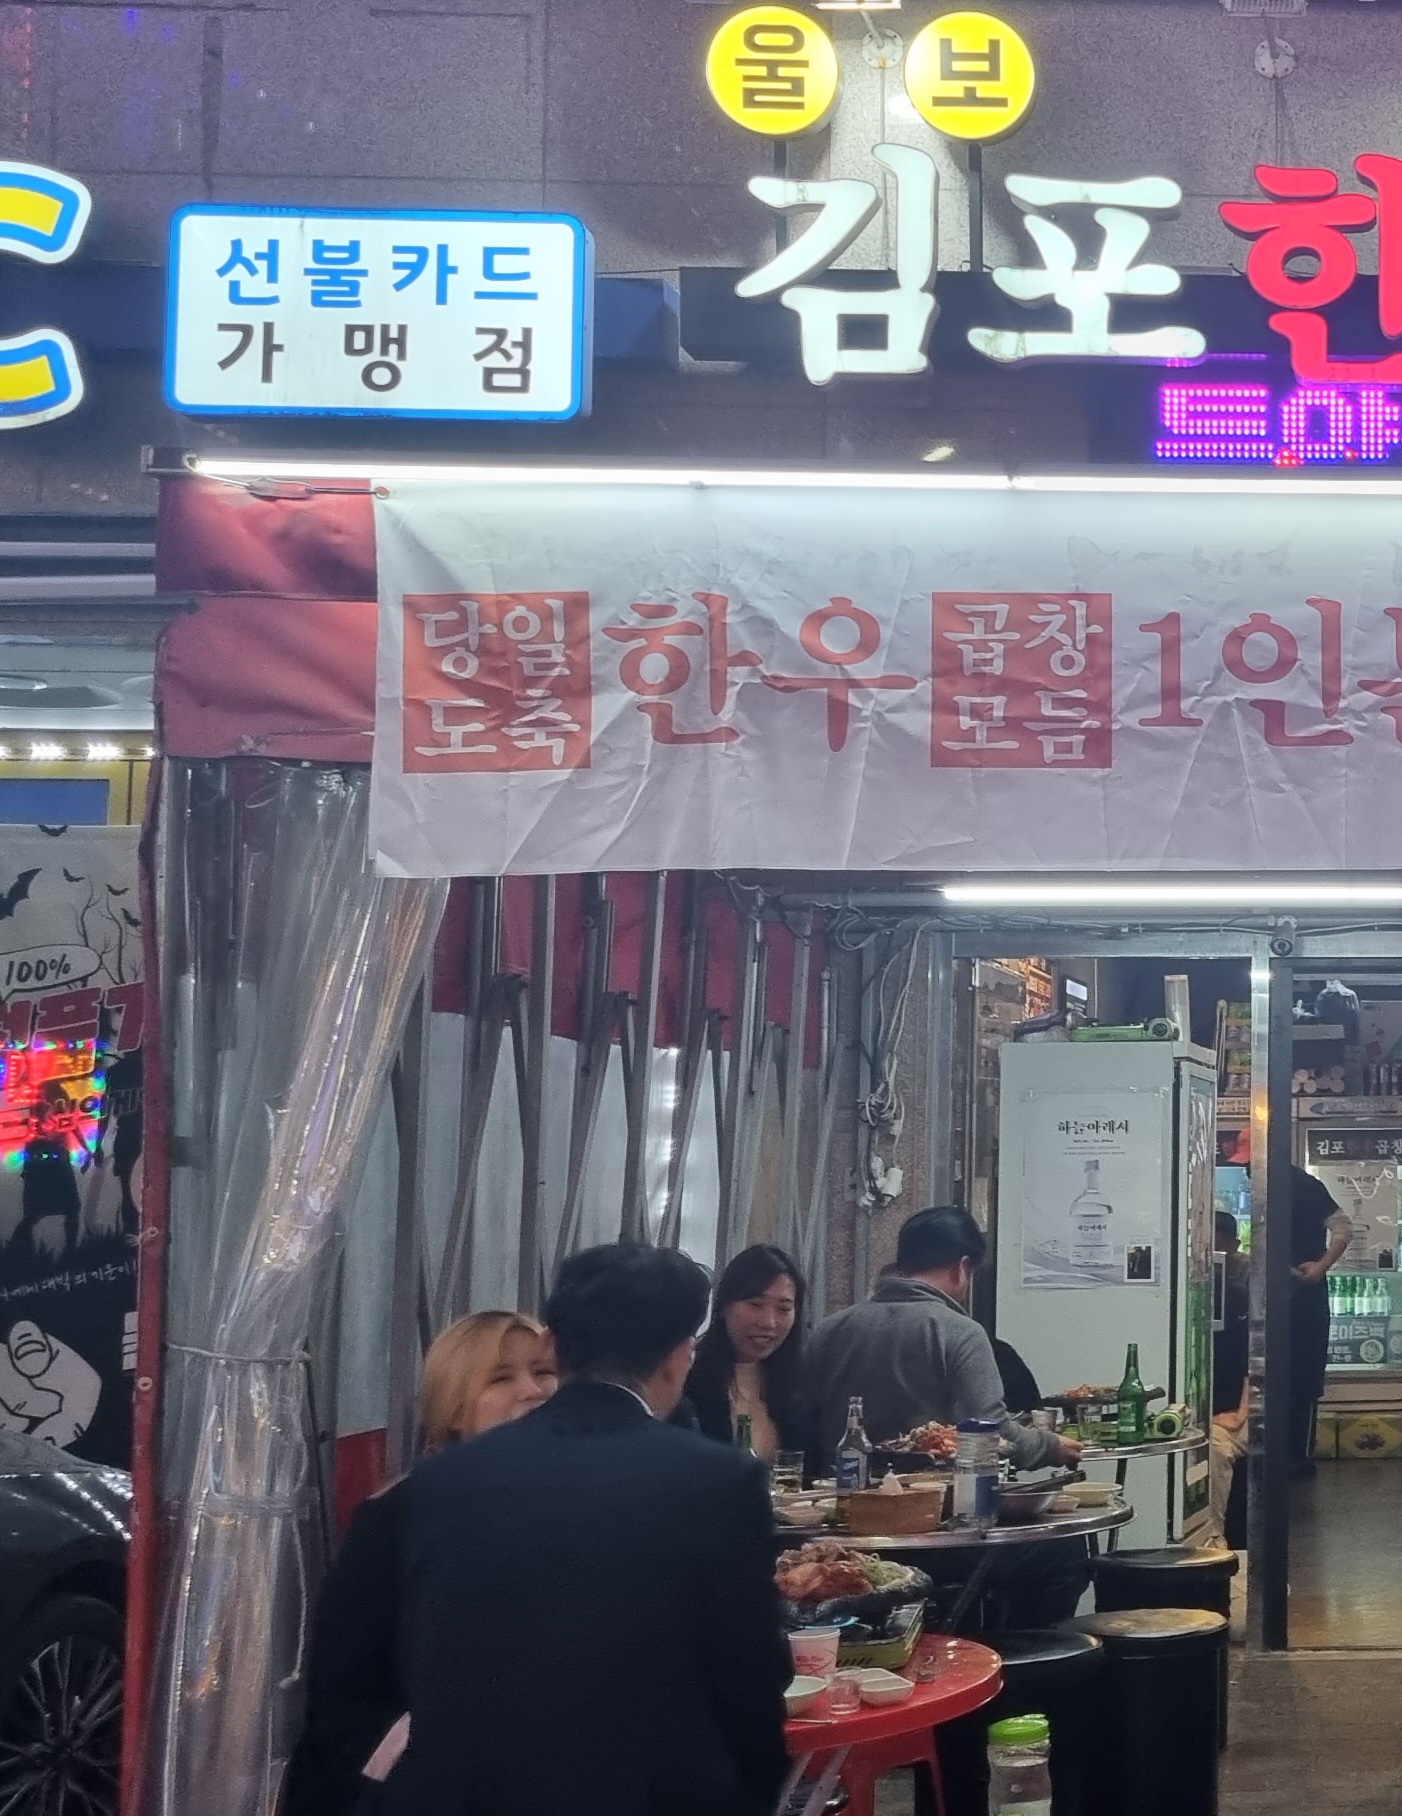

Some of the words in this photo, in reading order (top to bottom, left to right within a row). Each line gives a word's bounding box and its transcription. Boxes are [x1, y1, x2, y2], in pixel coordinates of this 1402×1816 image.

[734, 22, 1010, 112] 울보
[215, 237, 540, 310] 선불카드
[215, 321, 535, 394] 가맹점
[415, 599, 571, 680] 당일
[602, 591, 920, 753] 한우
[941, 599, 1105, 678] 곱창
[413, 689, 582, 767] 도축
[941, 689, 1104, 764] 모듬
[5, 953, 72, 986] 100%
[1316, 1139, 1346, 1156] 김포
